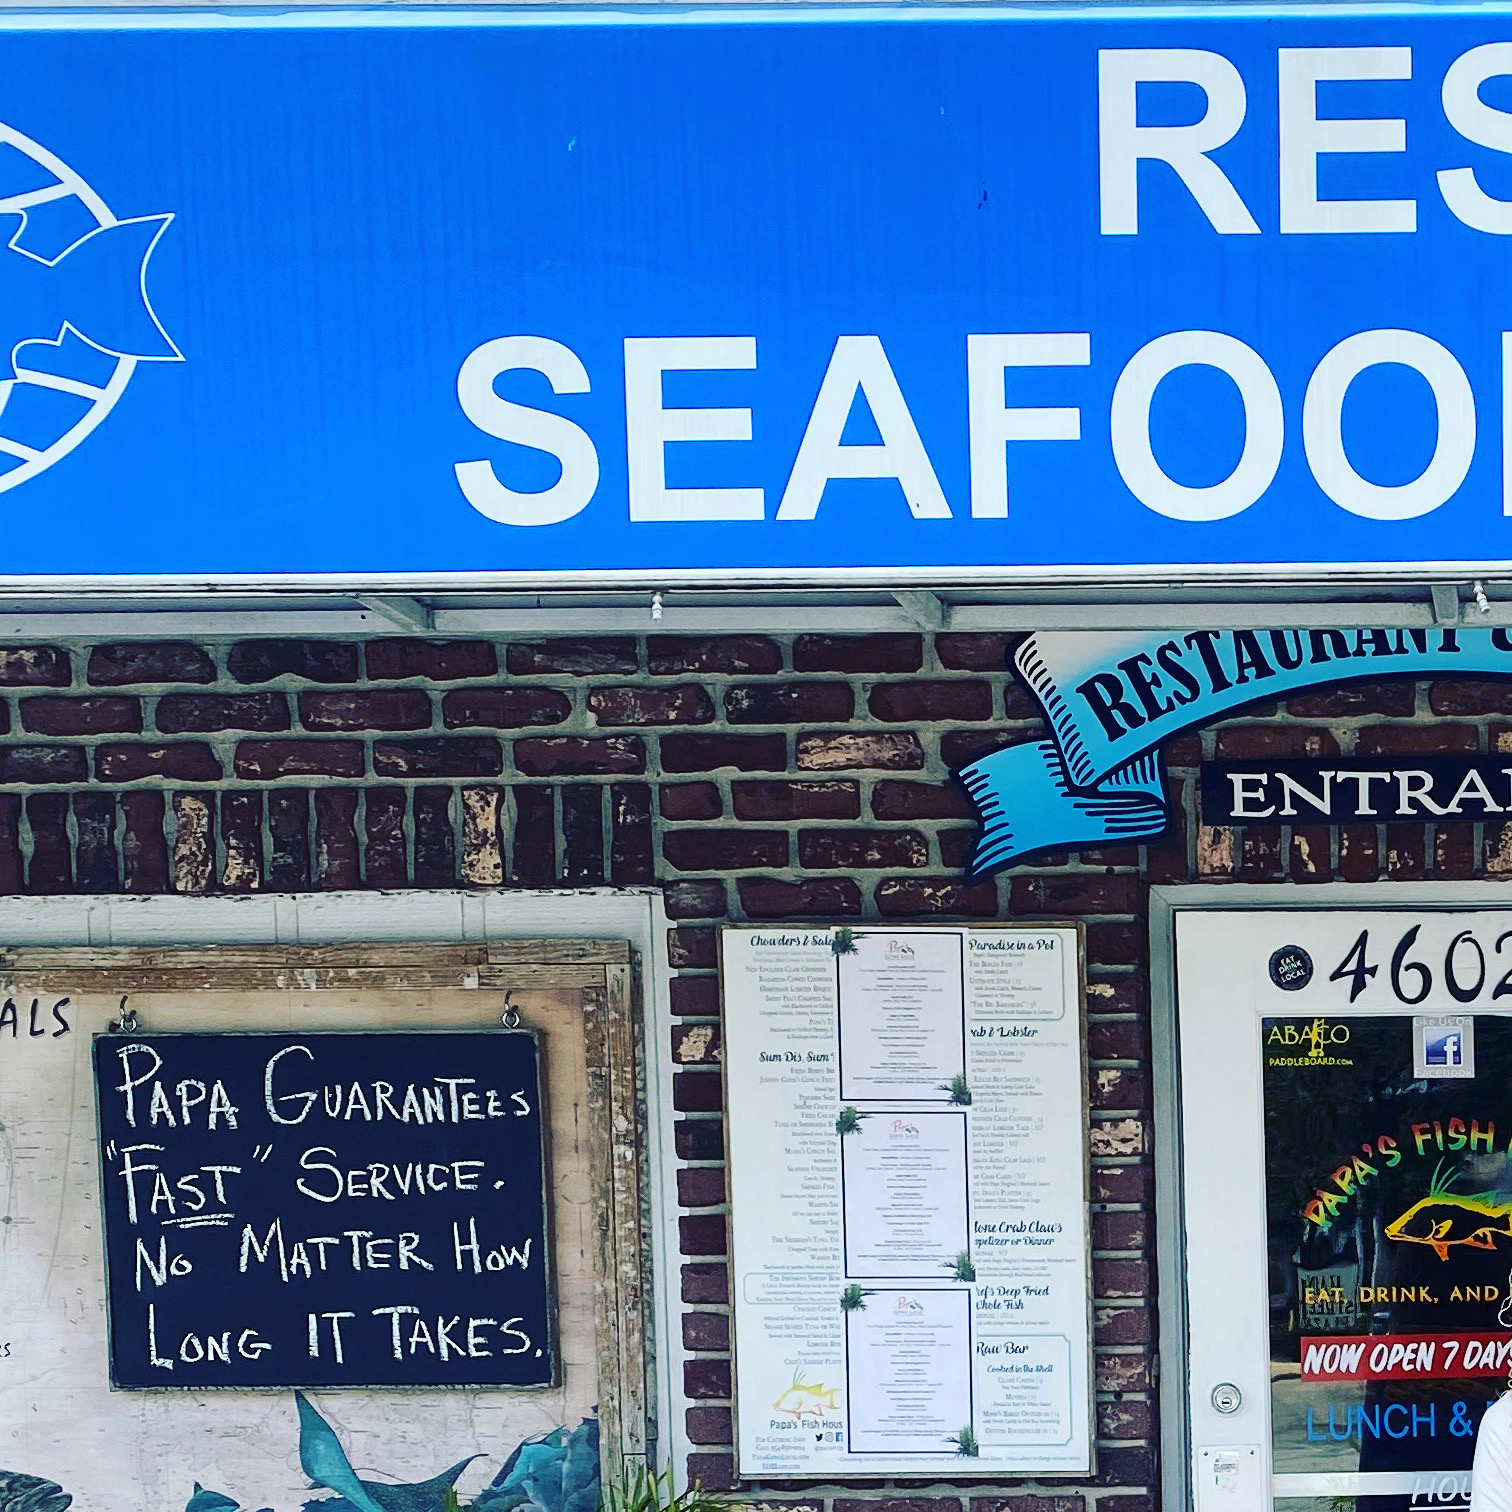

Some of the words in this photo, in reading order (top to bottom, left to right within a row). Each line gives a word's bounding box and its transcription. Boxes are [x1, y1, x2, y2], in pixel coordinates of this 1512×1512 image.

[750, 935, 801, 947] Chowders
[968, 938, 1015, 950] Paradise
[1036, 939, 1055, 950] Pot
[1278, 960, 1303, 974] DRINK
[1280, 969, 1306, 983] LOCAL
[1439, 1017, 1453, 1026] Us
[1455, 1017, 1472, 1026] On
[997, 1026, 1039, 1038] Lobster
[759, 1051, 781, 1063] Sum
[806, 1050, 830, 1063] Sum
[1415, 1068, 1473, 1078] Facebook
[115, 1043, 239, 1130] PAPA
[265, 1045, 531, 1125] GUARANTEES
[297, 1146, 506, 1203] SERVICE.
[1303, 1135, 1402, 1229] PAPA'S
[1411, 1116, 1495, 1156] FISH
[999, 1220, 1027, 1233] Crab
[1028, 1220, 1063, 1233] Claws
[1023, 1236, 1055, 1246] Dinner
[135, 1235, 194, 1292] NO
[239, 1217, 435, 1283] MATTER
[453, 1217, 533, 1275] HOW
[996, 1286, 1021, 1299] Deep
[1022, 1285, 1050, 1296] Fried
[1304, 1287, 1348, 1304] EAT,
[1360, 1286, 1439, 1304] DRINK,
[1450, 1286, 1499, 1302] AND
[1003, 1299, 1025, 1310] Fish
[149, 1303, 273, 1370] LONG
[307, 1311, 356, 1364] IT
[371, 1305, 544, 1363] TAKES.
[977, 1341, 1002, 1356] Raw
[1004, 1341, 1030, 1354] Bar
[1303, 1342, 1366, 1374] NOW
[1369, 1341, 1436, 1373] OPEN
[1442, 1341, 1460, 1370] 7
[769, 1420, 798, 1431] Papa's
[801, 1420, 820, 1429] Fish
[1306, 1402, 1436, 1442] LUNCH
[1449, 1401, 1473, 1438] &
